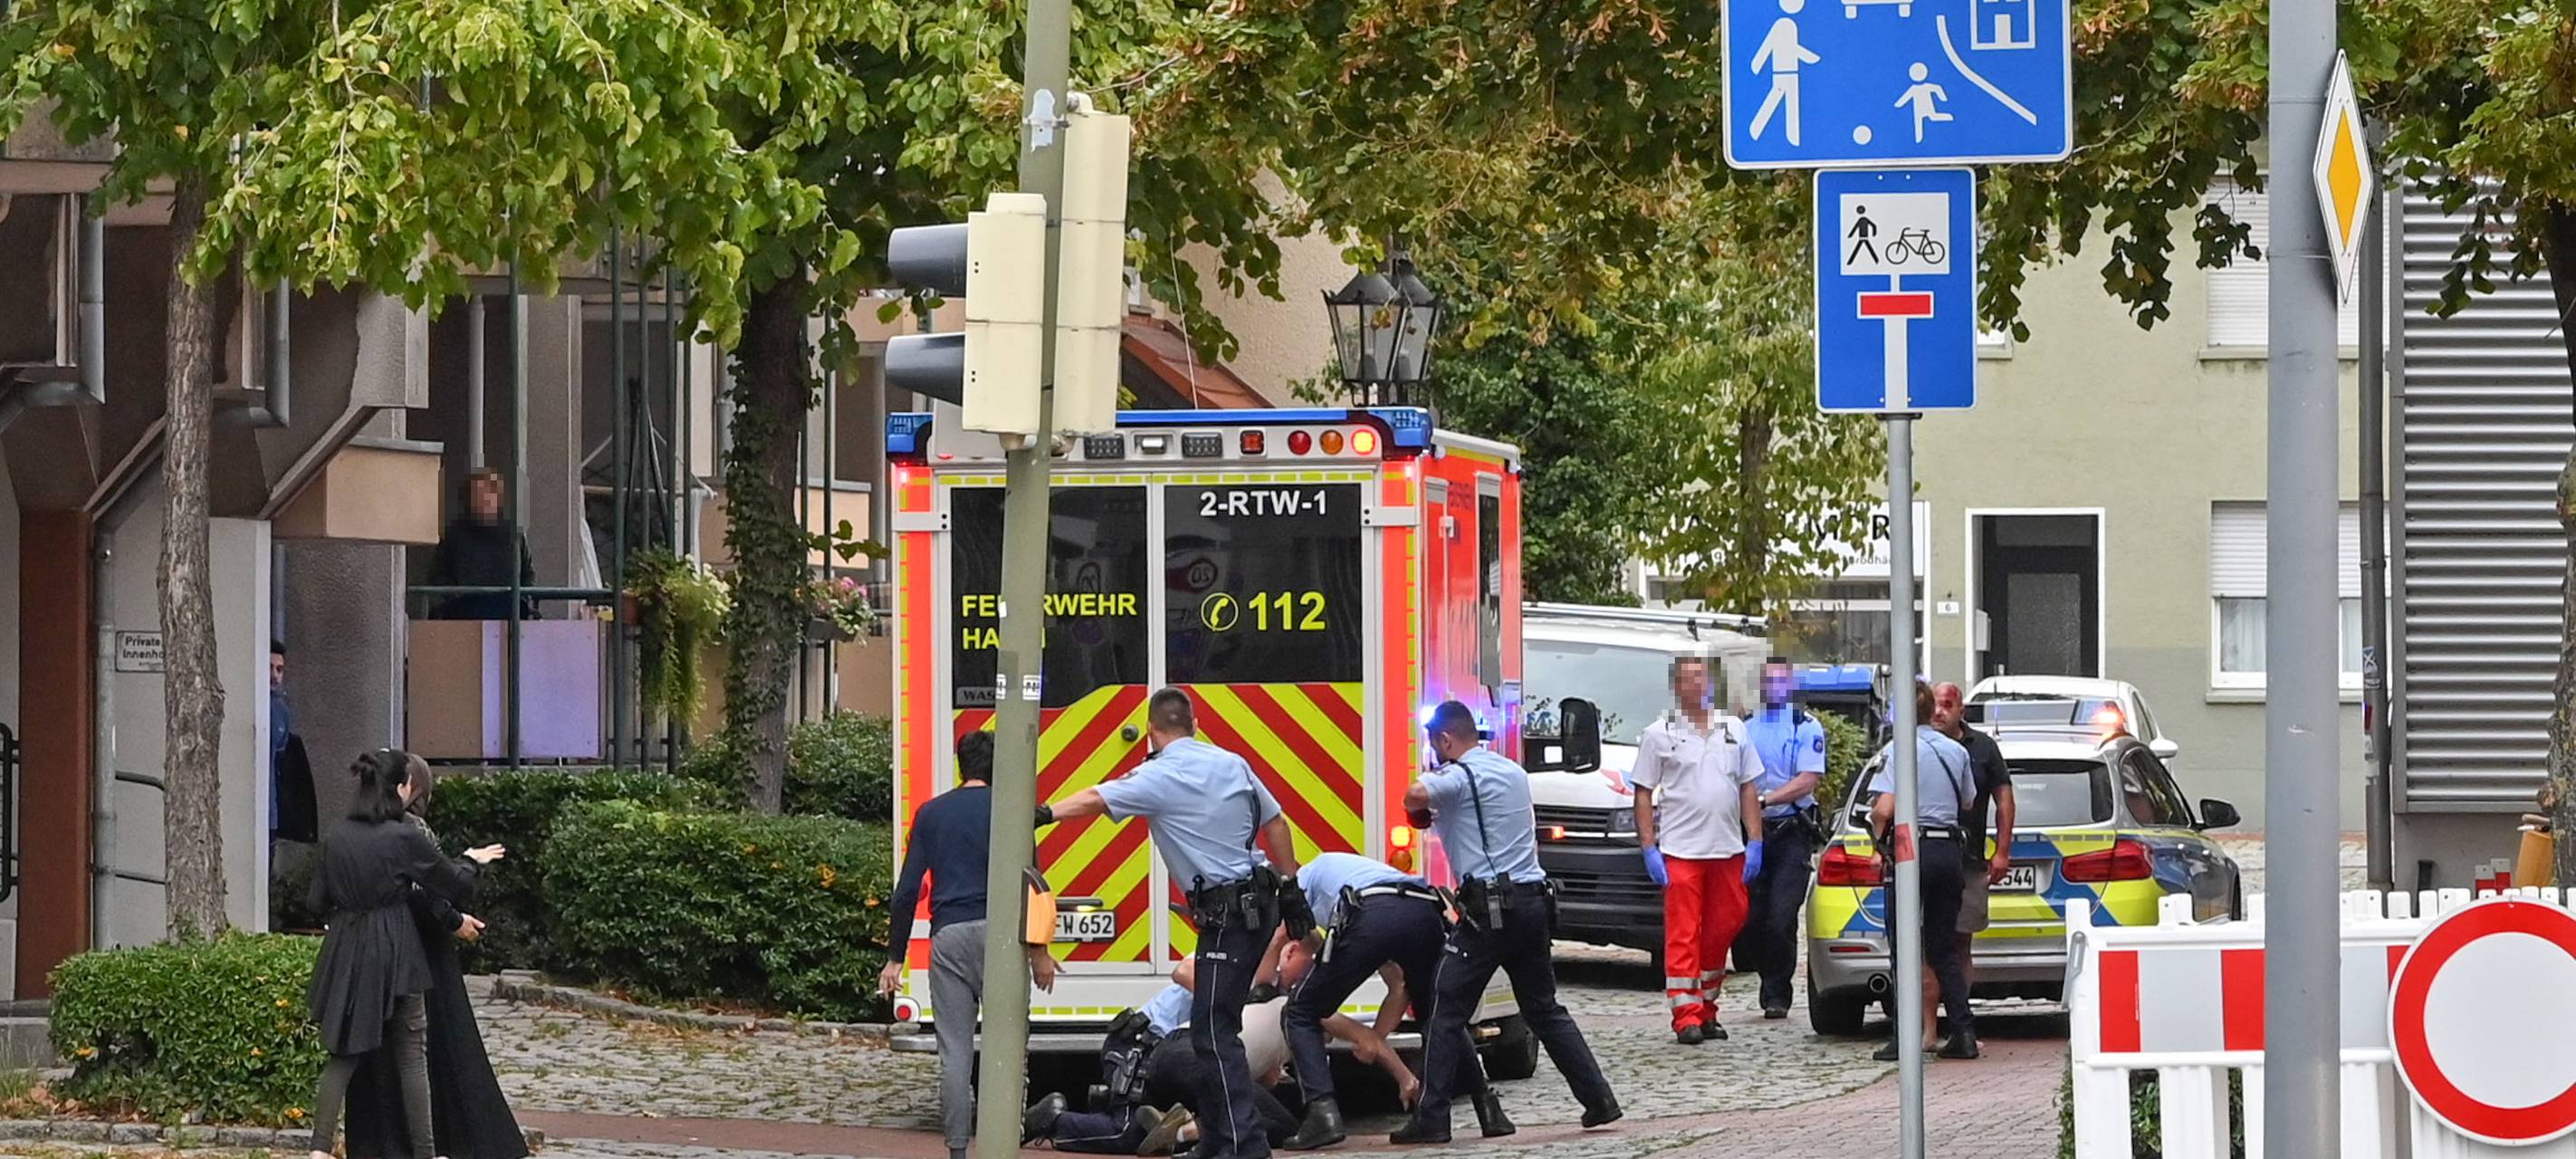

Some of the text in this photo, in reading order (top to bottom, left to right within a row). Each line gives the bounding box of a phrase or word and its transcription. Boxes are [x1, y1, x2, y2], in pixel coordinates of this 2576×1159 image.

[1200, 490, 1326, 516] 2-RTW-1
[962, 593, 1137, 618] FERWEHR
[1249, 591, 1326, 630] 112
[962, 627, 1046, 650] HA
[123, 648, 165, 659] Innenho
[1997, 868, 2033, 886] 544
[1078, 915, 1113, 934] 652
